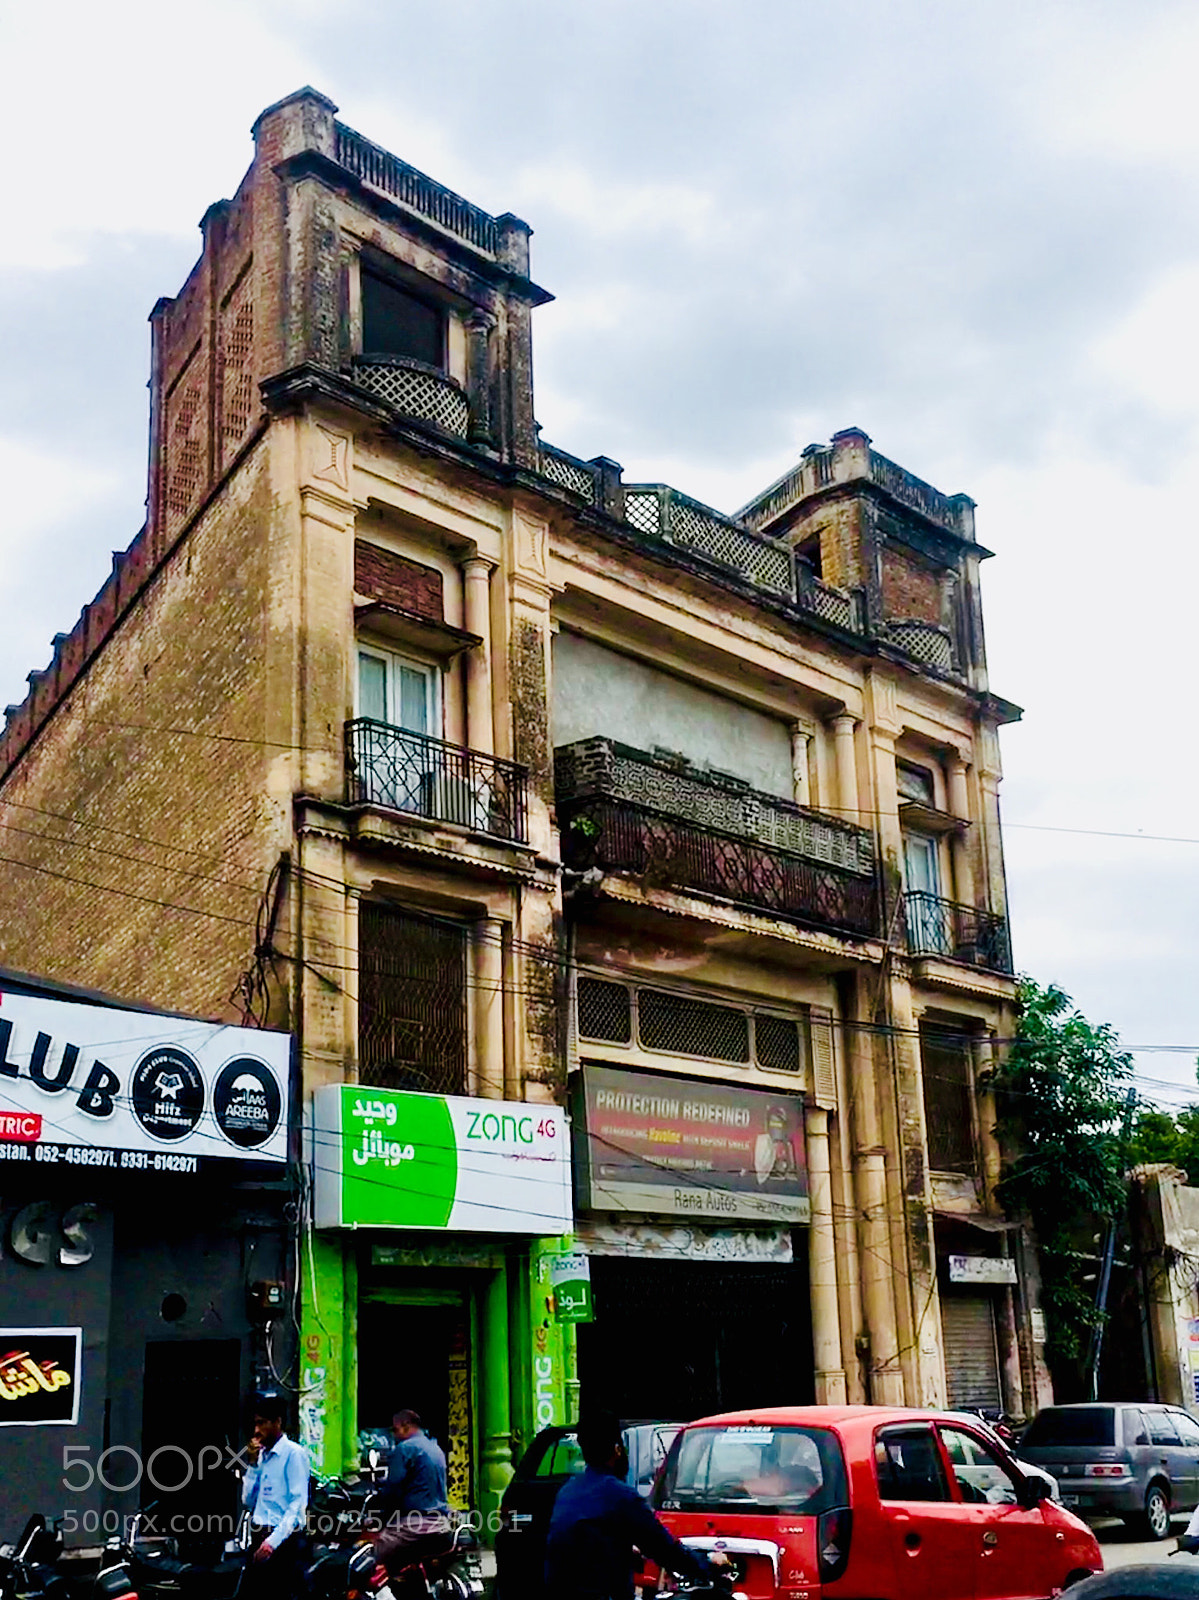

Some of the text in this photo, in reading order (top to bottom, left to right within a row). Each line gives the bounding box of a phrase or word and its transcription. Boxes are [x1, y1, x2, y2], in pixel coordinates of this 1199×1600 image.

[225, 1104, 269, 1121] AREEBA
[352, 1099, 398, 1126] وحید
[596, 1090, 751, 1128] PROTECTION REDEFINED
[536, 1119, 557, 1138] 4G
[352, 1129, 415, 1167] موبائل
[674, 1189, 702, 1209] Rana
[706, 1192, 738, 1212] Autos
